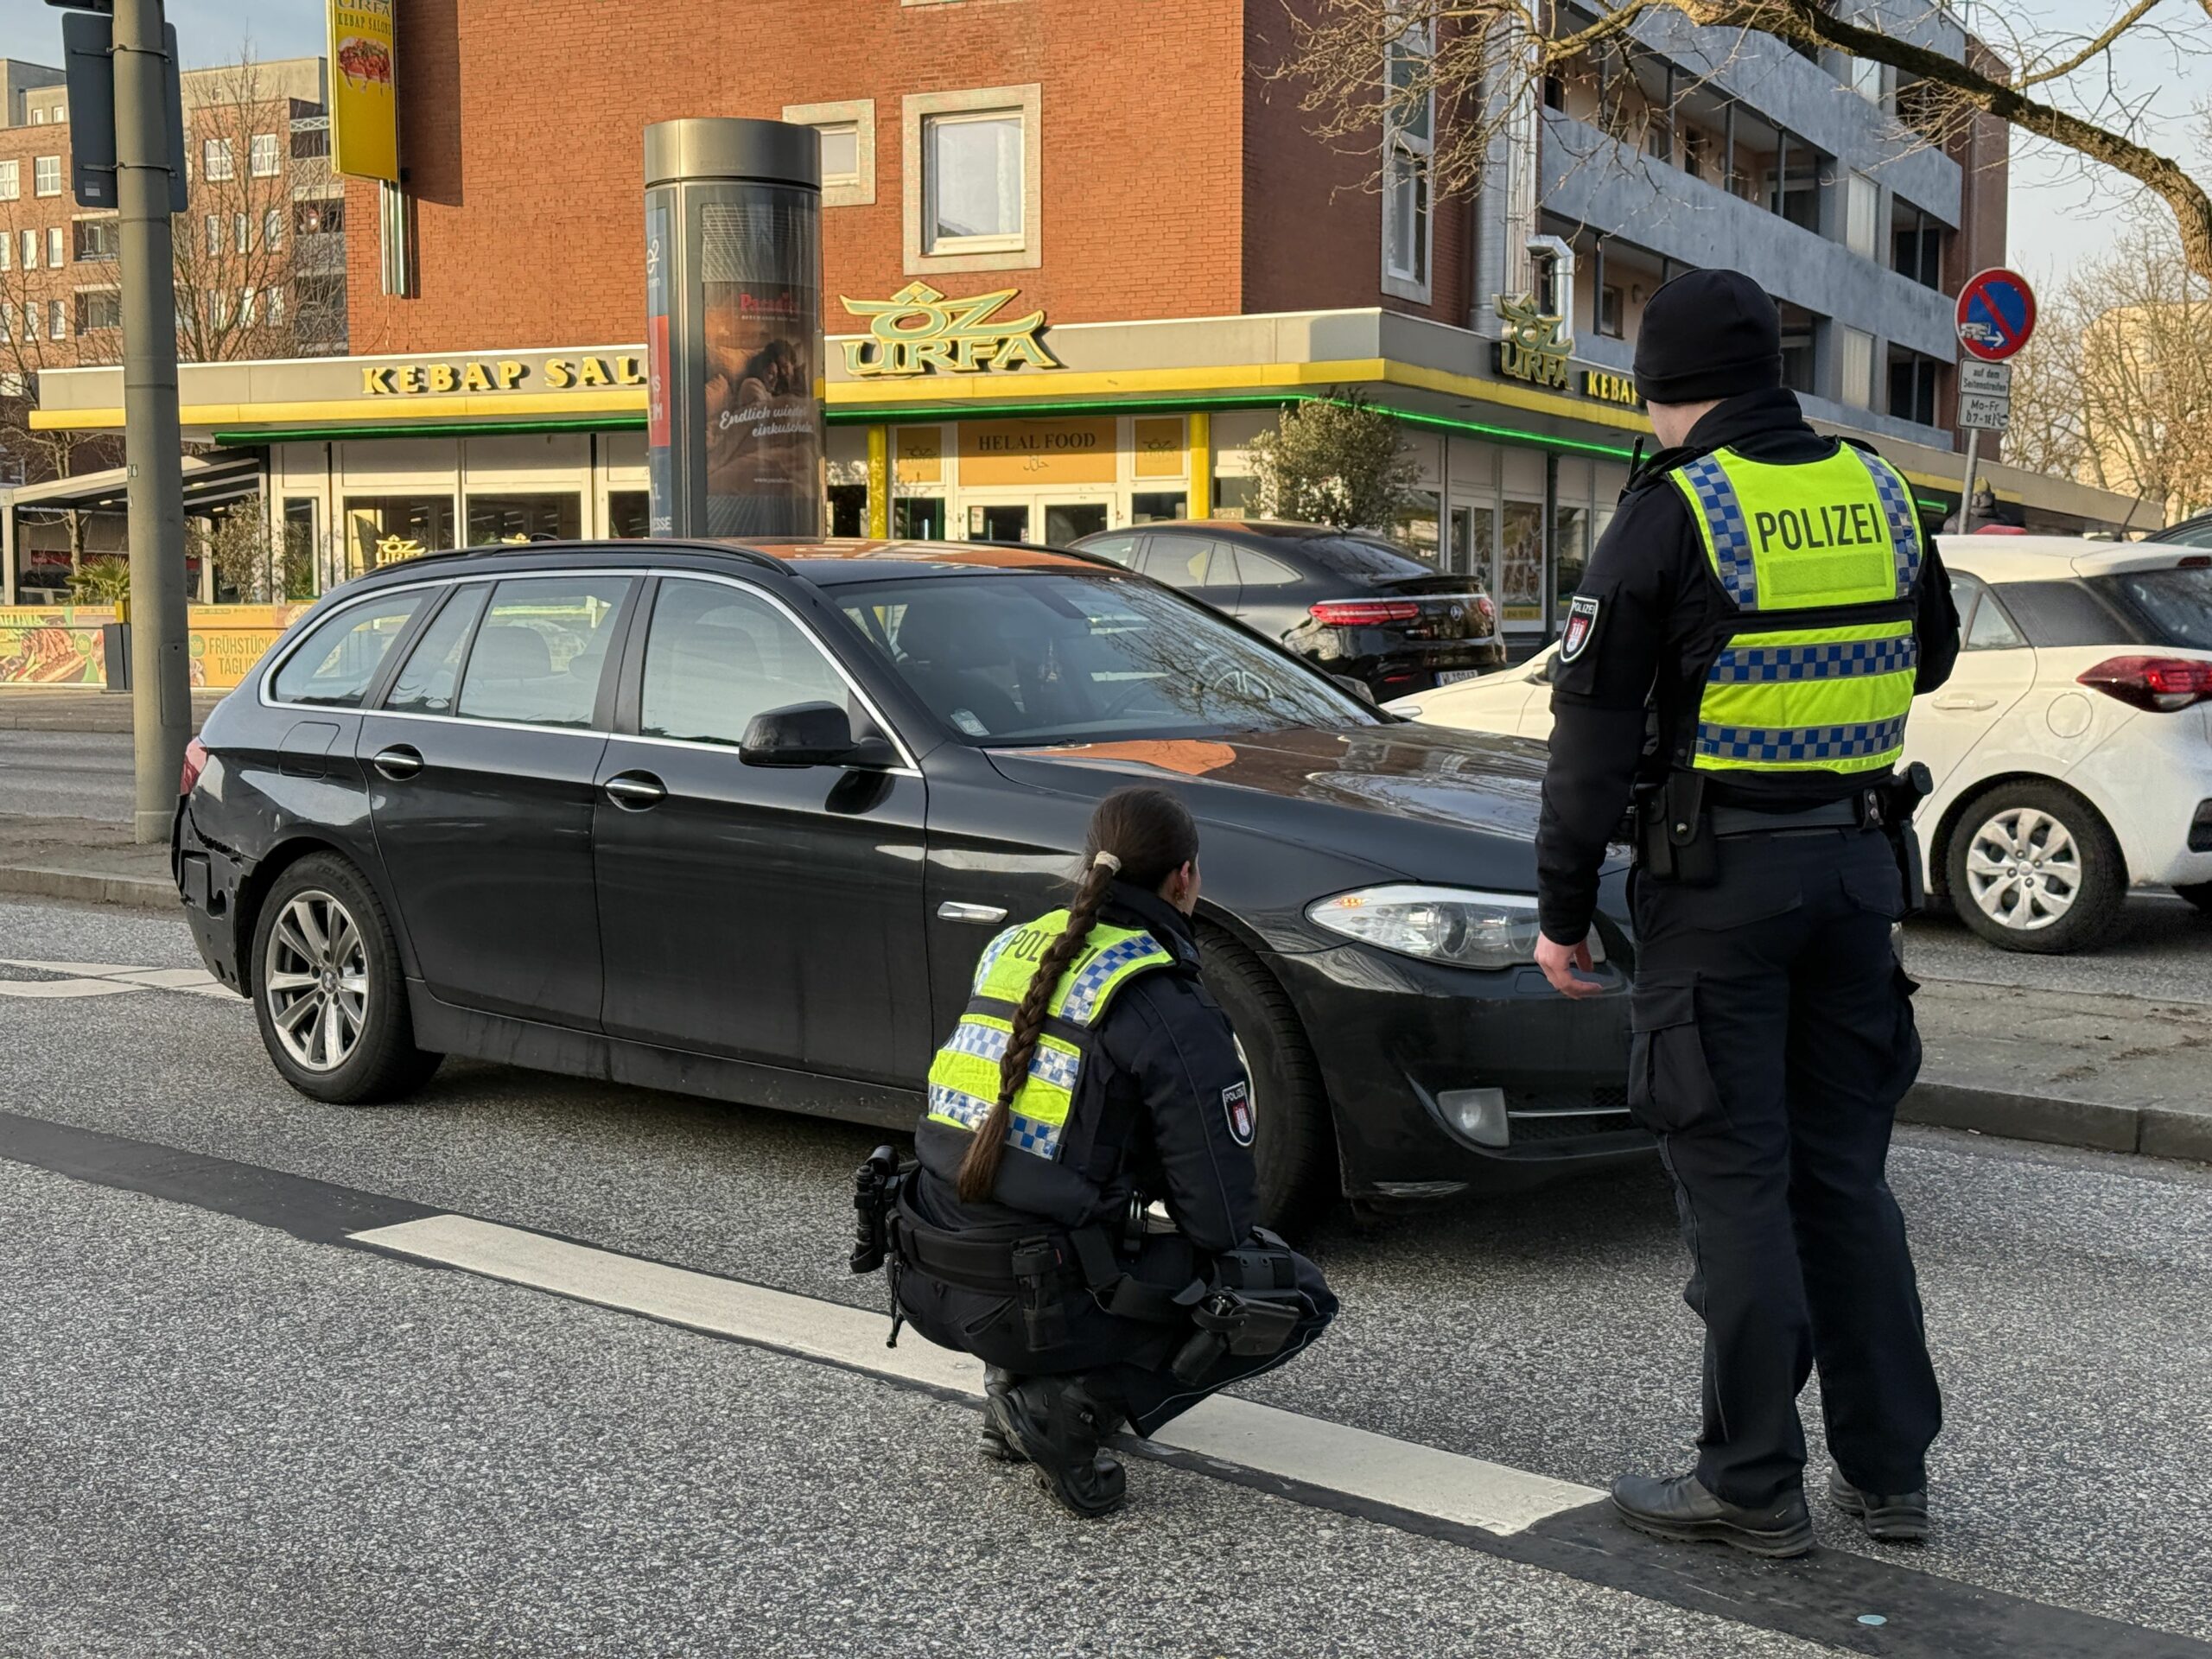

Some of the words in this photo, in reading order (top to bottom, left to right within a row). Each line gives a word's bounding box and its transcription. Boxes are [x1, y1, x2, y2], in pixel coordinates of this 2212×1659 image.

[338, 13, 365, 29] KEBAP
[839, 281, 1044, 340] ÖZ
[1491, 290, 1573, 359] ÖZ
[842, 336, 1058, 375] URFA
[361, 360, 522, 394] KEBAP
[543, 355, 641, 389] SAL
[1501, 341, 1574, 391] URFA
[1973, 368, 1985, 377] auf
[1986, 369, 1999, 378] dem
[1963, 378, 2006, 391] Seitenstreifen
[1971, 399, 1999, 411] Mo-Fr
[719, 406, 771, 429] Endlich
[978, 435, 1040, 450] HELAL
[1044, 432, 1096, 448] FOOD
[1755, 503, 1882, 553] POLIZEI
[375, 534, 426, 554] ÖZ
[1573, 601, 1596, 614] POLIZEI
[208, 634, 272, 654] FRÜHSTÜCK
[1224, 1088, 1245, 1103] POLIZEI
